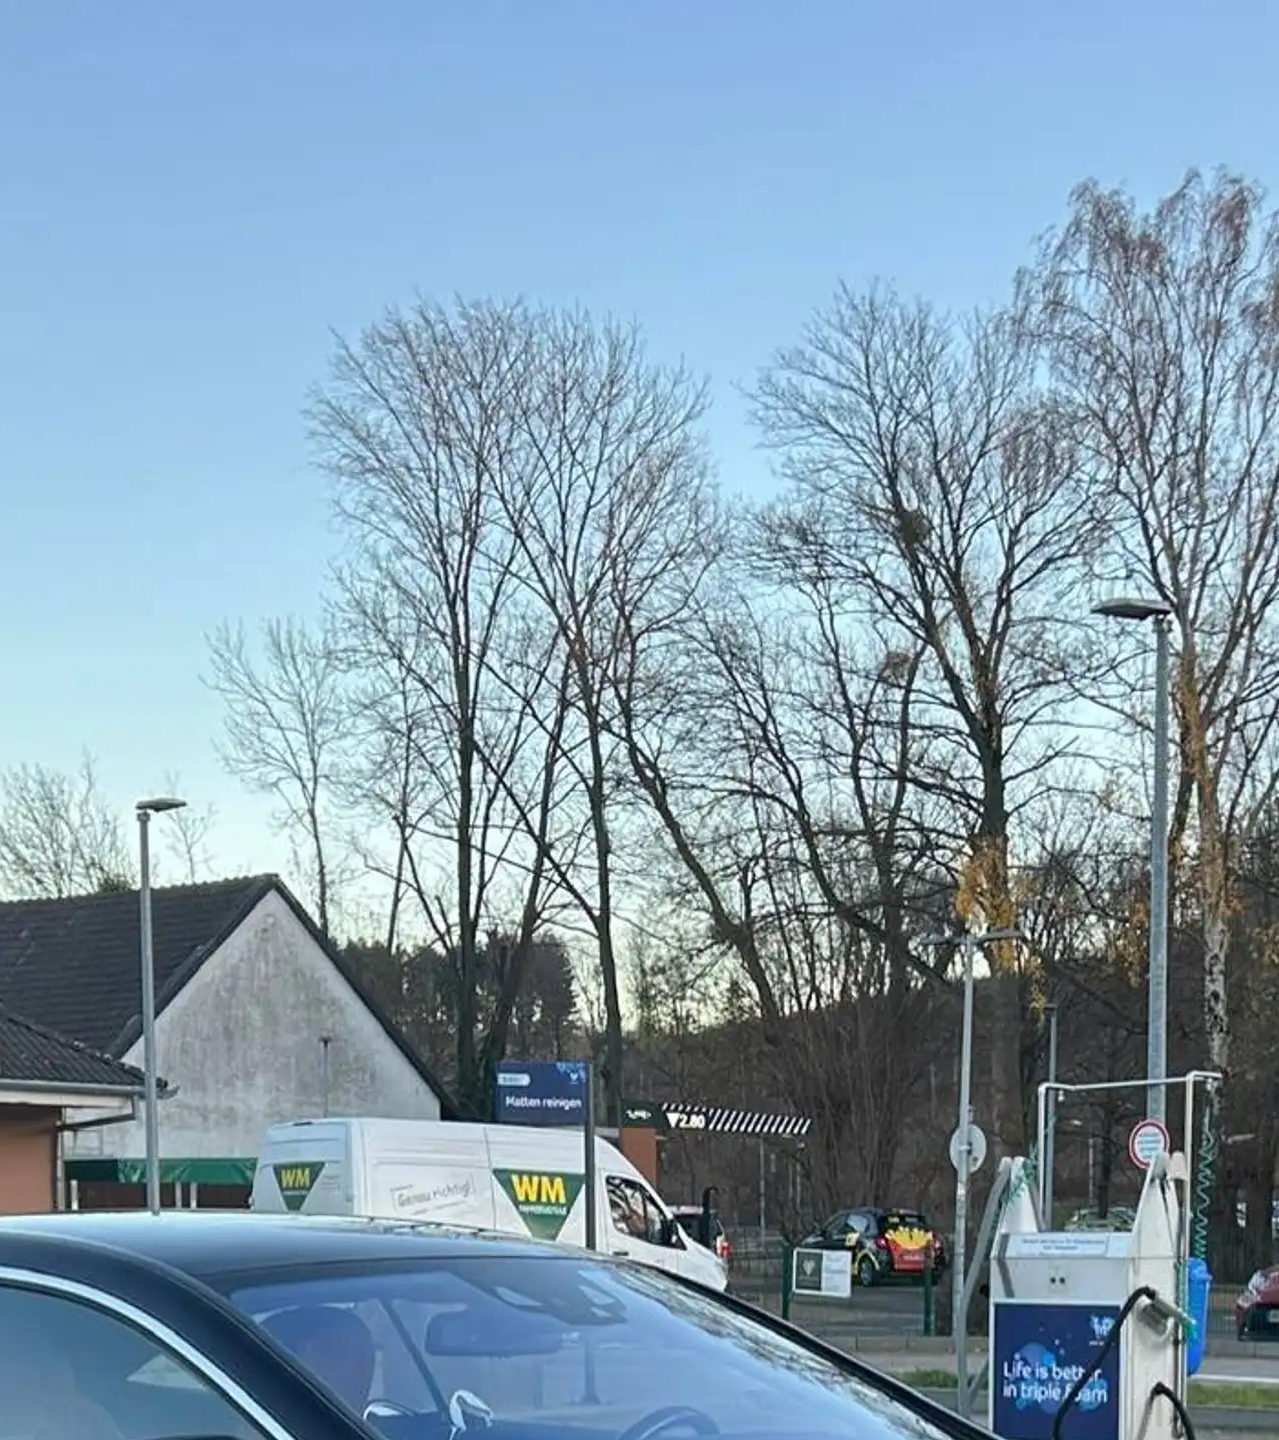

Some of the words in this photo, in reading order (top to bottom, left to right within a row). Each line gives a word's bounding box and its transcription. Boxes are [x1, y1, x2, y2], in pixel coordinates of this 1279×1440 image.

[505, 1095, 541, 1108] Matten
[543, 1096, 582, 1111] reinigen
[281, 1167, 311, 1189] WM
[511, 1173, 566, 1204] WM
[1003, 1360, 1032, 1377] Life
[1035, 1363, 1049, 1380] is
[1051, 1362, 1102, 1381] bettr
[1003, 1380, 1017, 1397] in
[1020, 1382, 1062, 1404] triple
[1063, 1383, 1108, 1404] fam
